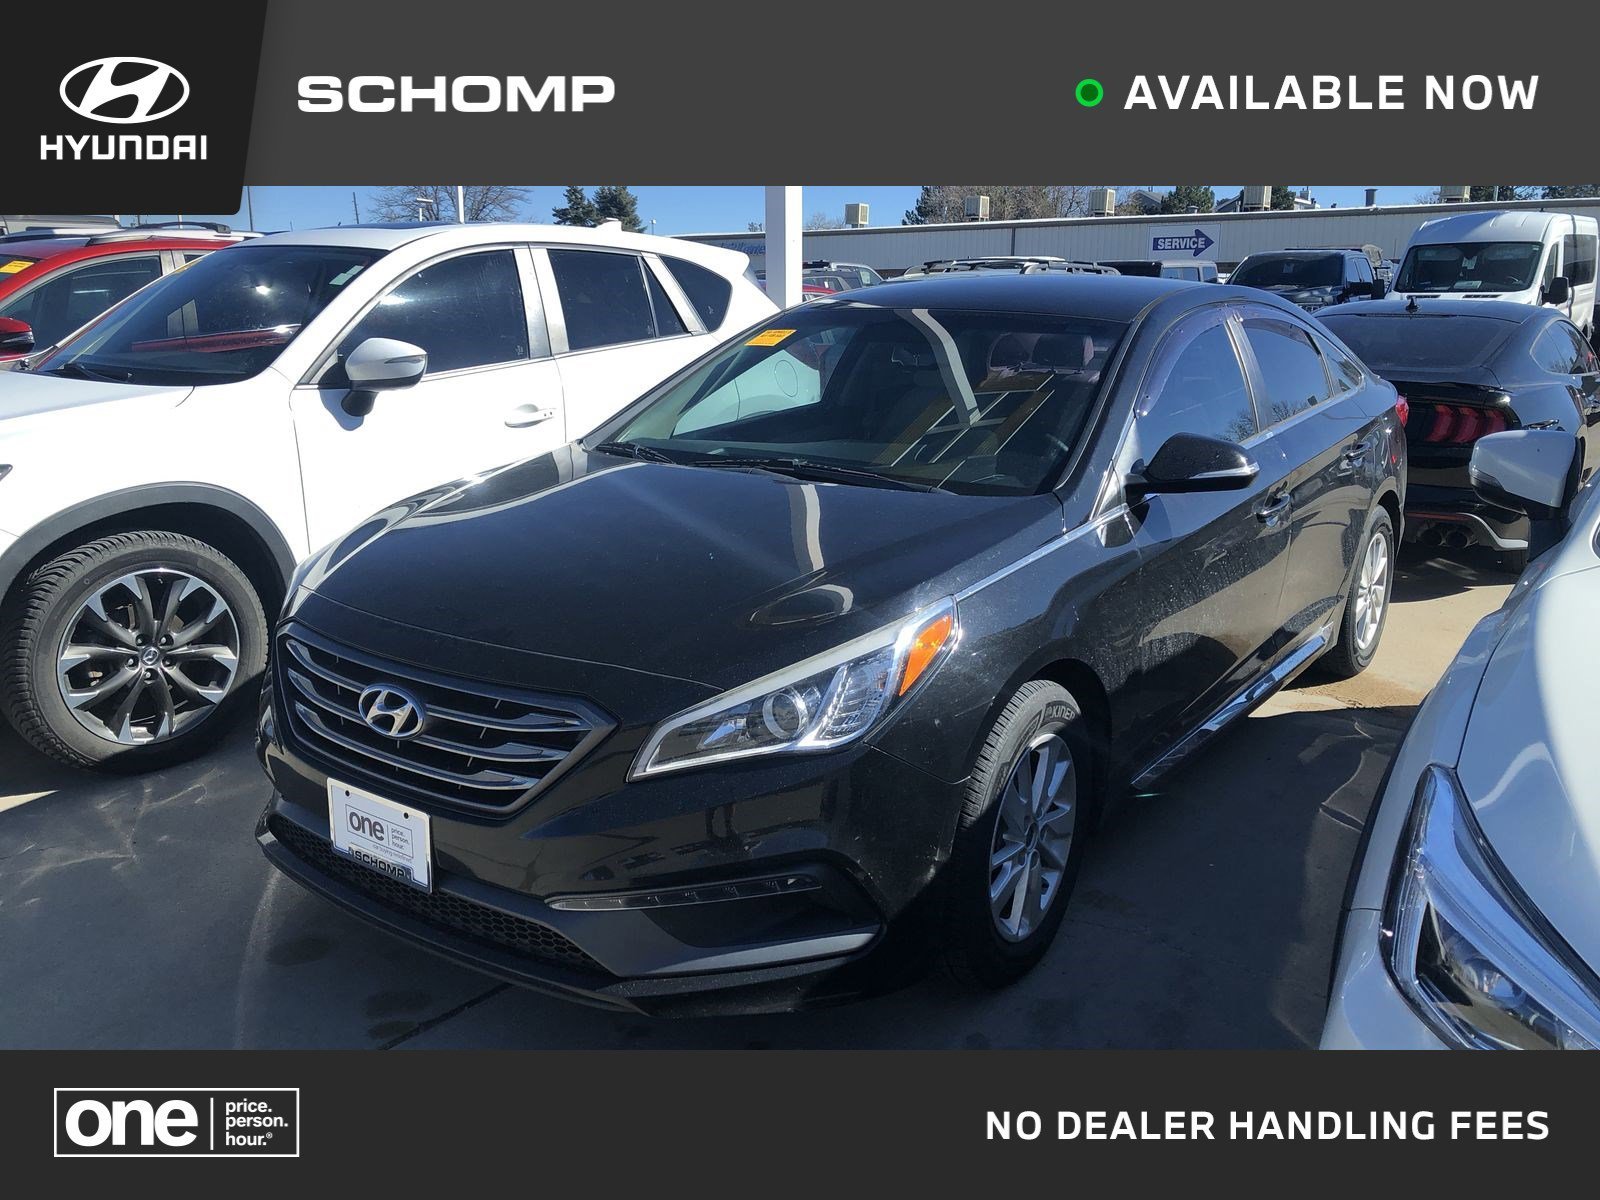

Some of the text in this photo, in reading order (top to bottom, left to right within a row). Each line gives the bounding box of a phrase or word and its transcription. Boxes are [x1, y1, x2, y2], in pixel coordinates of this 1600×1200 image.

[1157, 237, 1205, 249] SERVICE
[349, 811, 385, 842] one
[354, 850, 405, 877] SCHOMP
